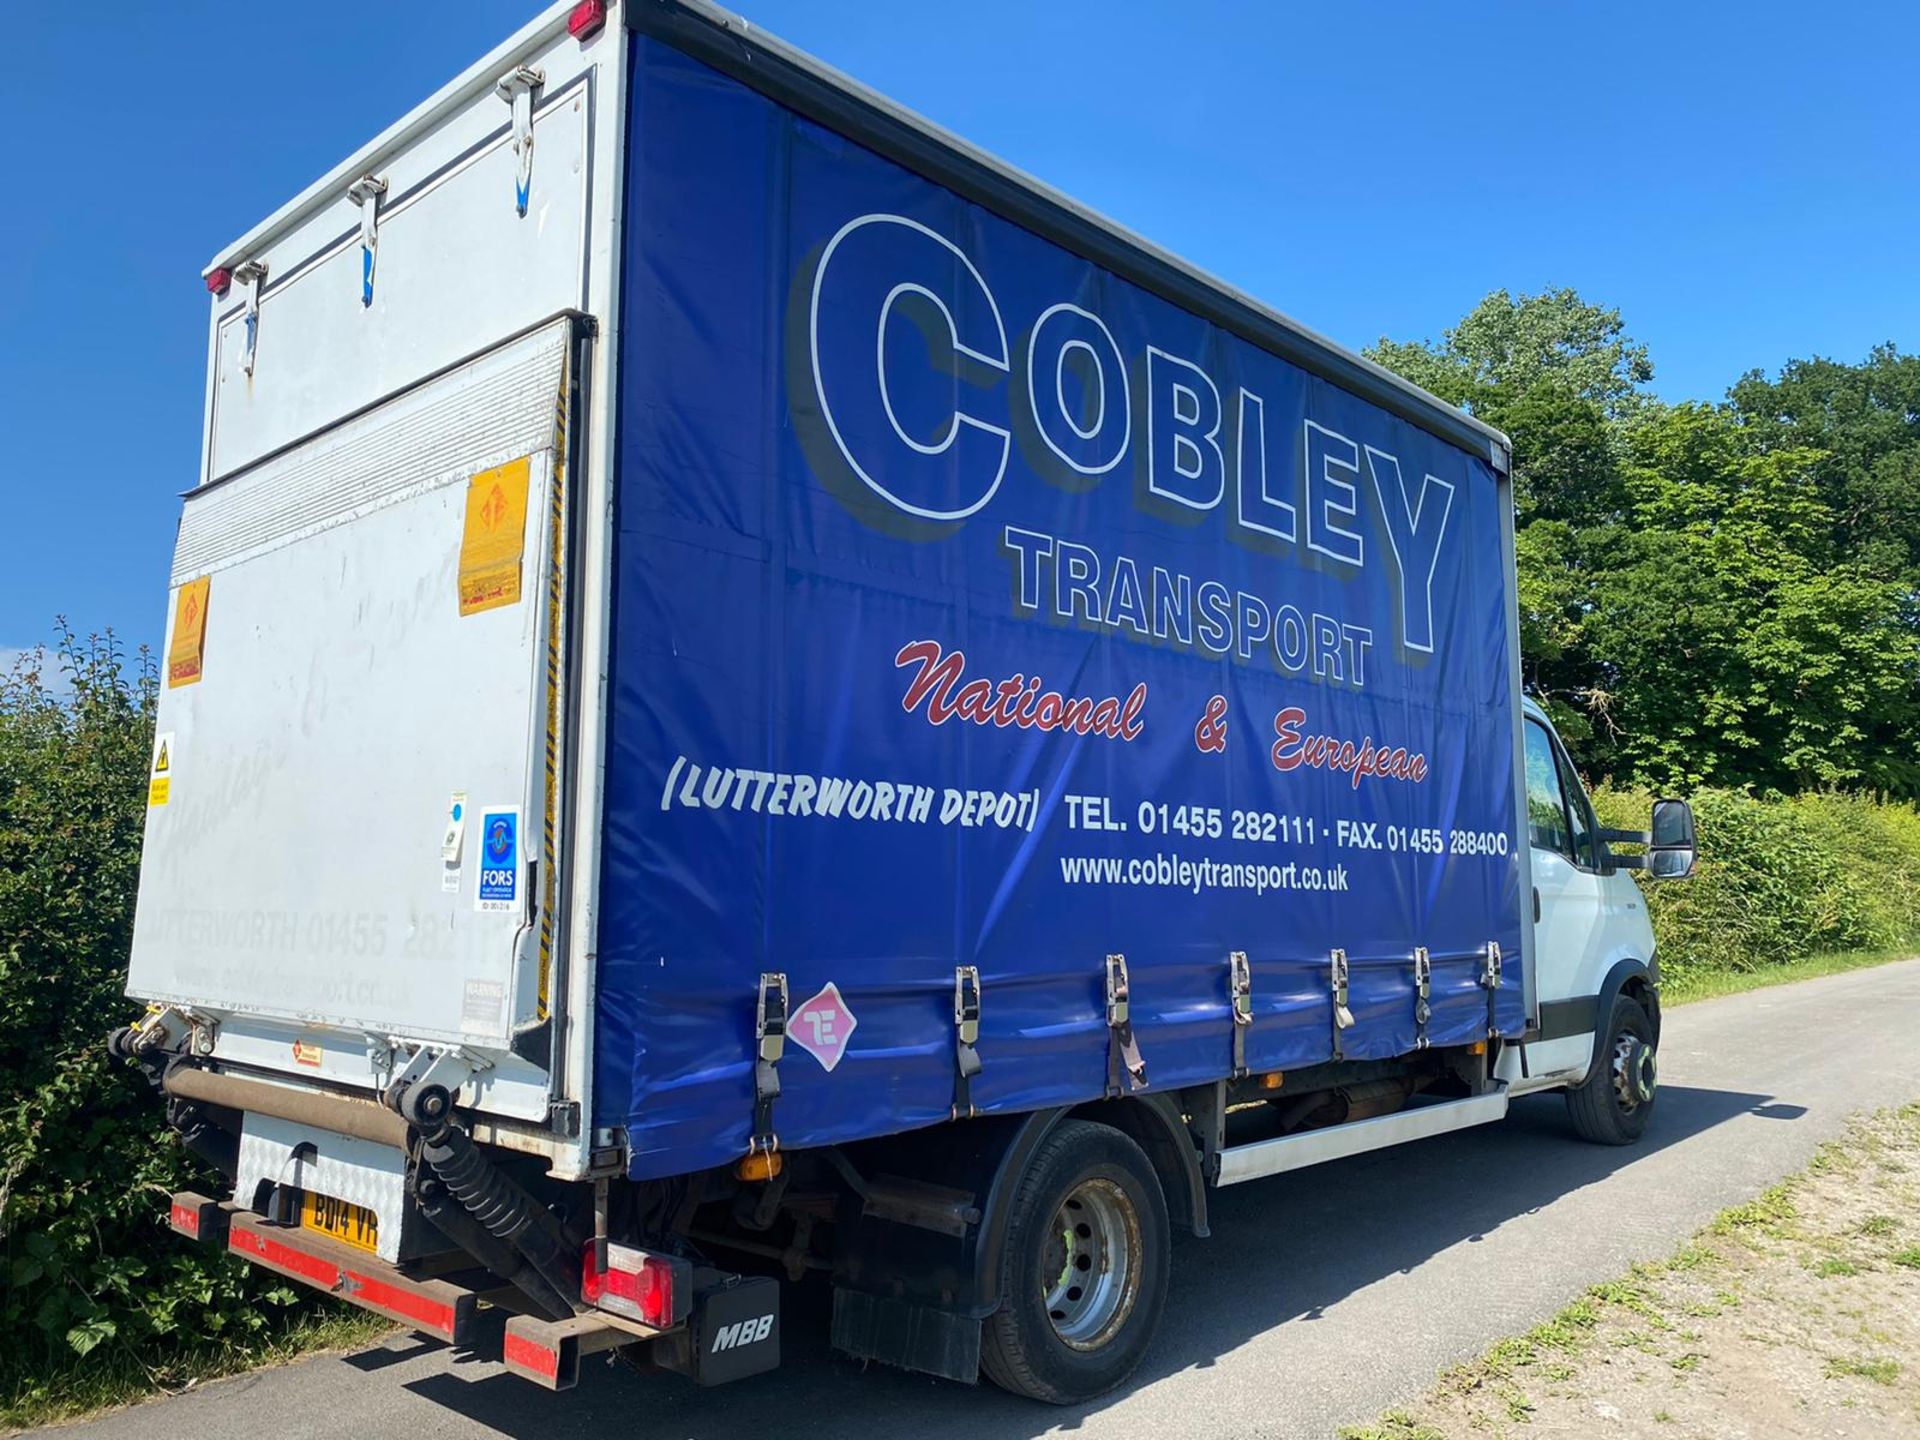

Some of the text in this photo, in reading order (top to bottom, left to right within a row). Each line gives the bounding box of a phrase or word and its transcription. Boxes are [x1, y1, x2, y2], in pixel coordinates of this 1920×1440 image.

[811, 213, 1454, 653] COBLEY
[1005, 526, 1372, 687] TRANSPORT
[895, 639, 1429, 790] National & European
[660, 755, 1041, 833] (LUTTERWORTH DEPOT)
[1064, 794, 1127, 832] TEL.
[1137, 800, 1222, 838] 01455
[1231, 810, 1315, 845] 282111
[1337, 819, 1383, 851] FAX.
[1386, 823, 1443, 855] 01455
[1449, 828, 1509, 857] 288400
[482, 869, 513, 886] FORS
[1059, 853, 1349, 896] www.cobleytransport.co.uk
[711, 1313, 775, 1354] MBB
